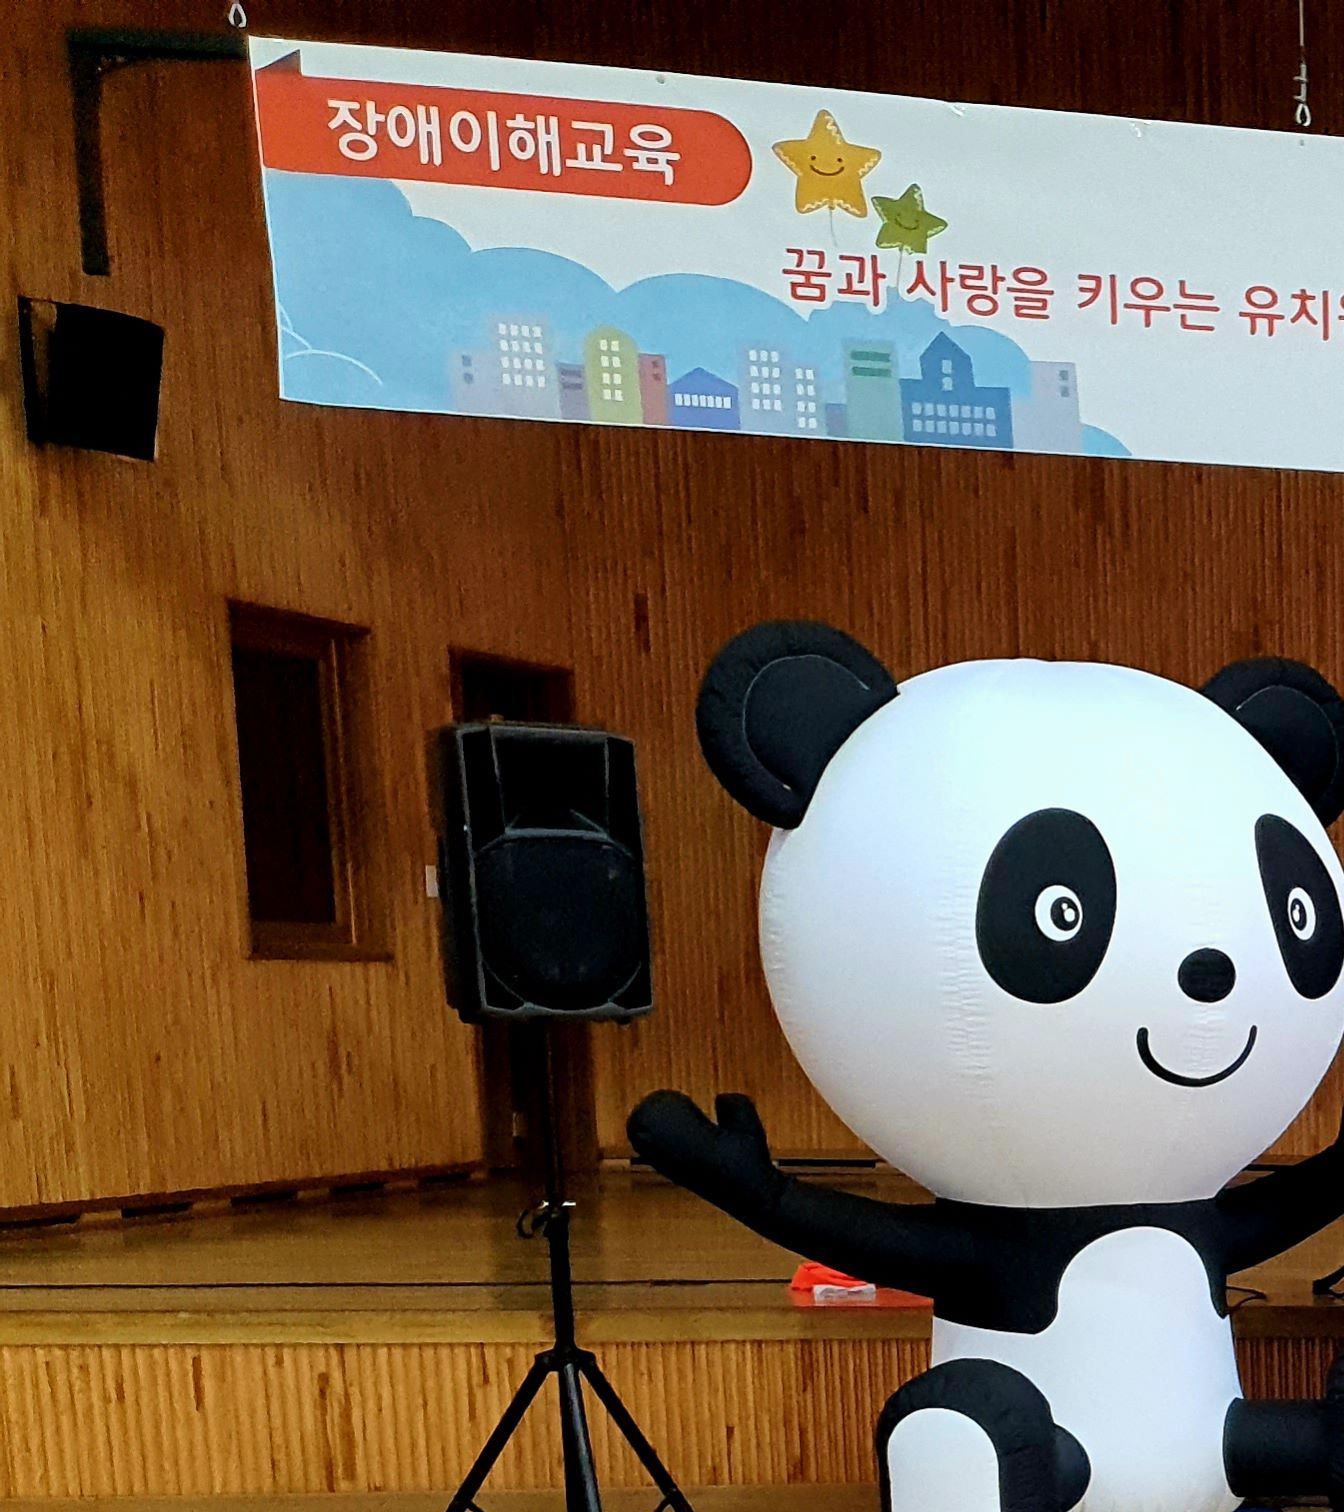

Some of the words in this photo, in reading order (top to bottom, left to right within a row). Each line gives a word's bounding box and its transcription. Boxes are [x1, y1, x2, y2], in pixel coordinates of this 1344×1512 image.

[328, 99, 681, 186] 장애이해교육
[782, 248, 886, 301] 꿈과
[906, 260, 1055, 319] 사랑을
[1077, 272, 1220, 332] 키우는
